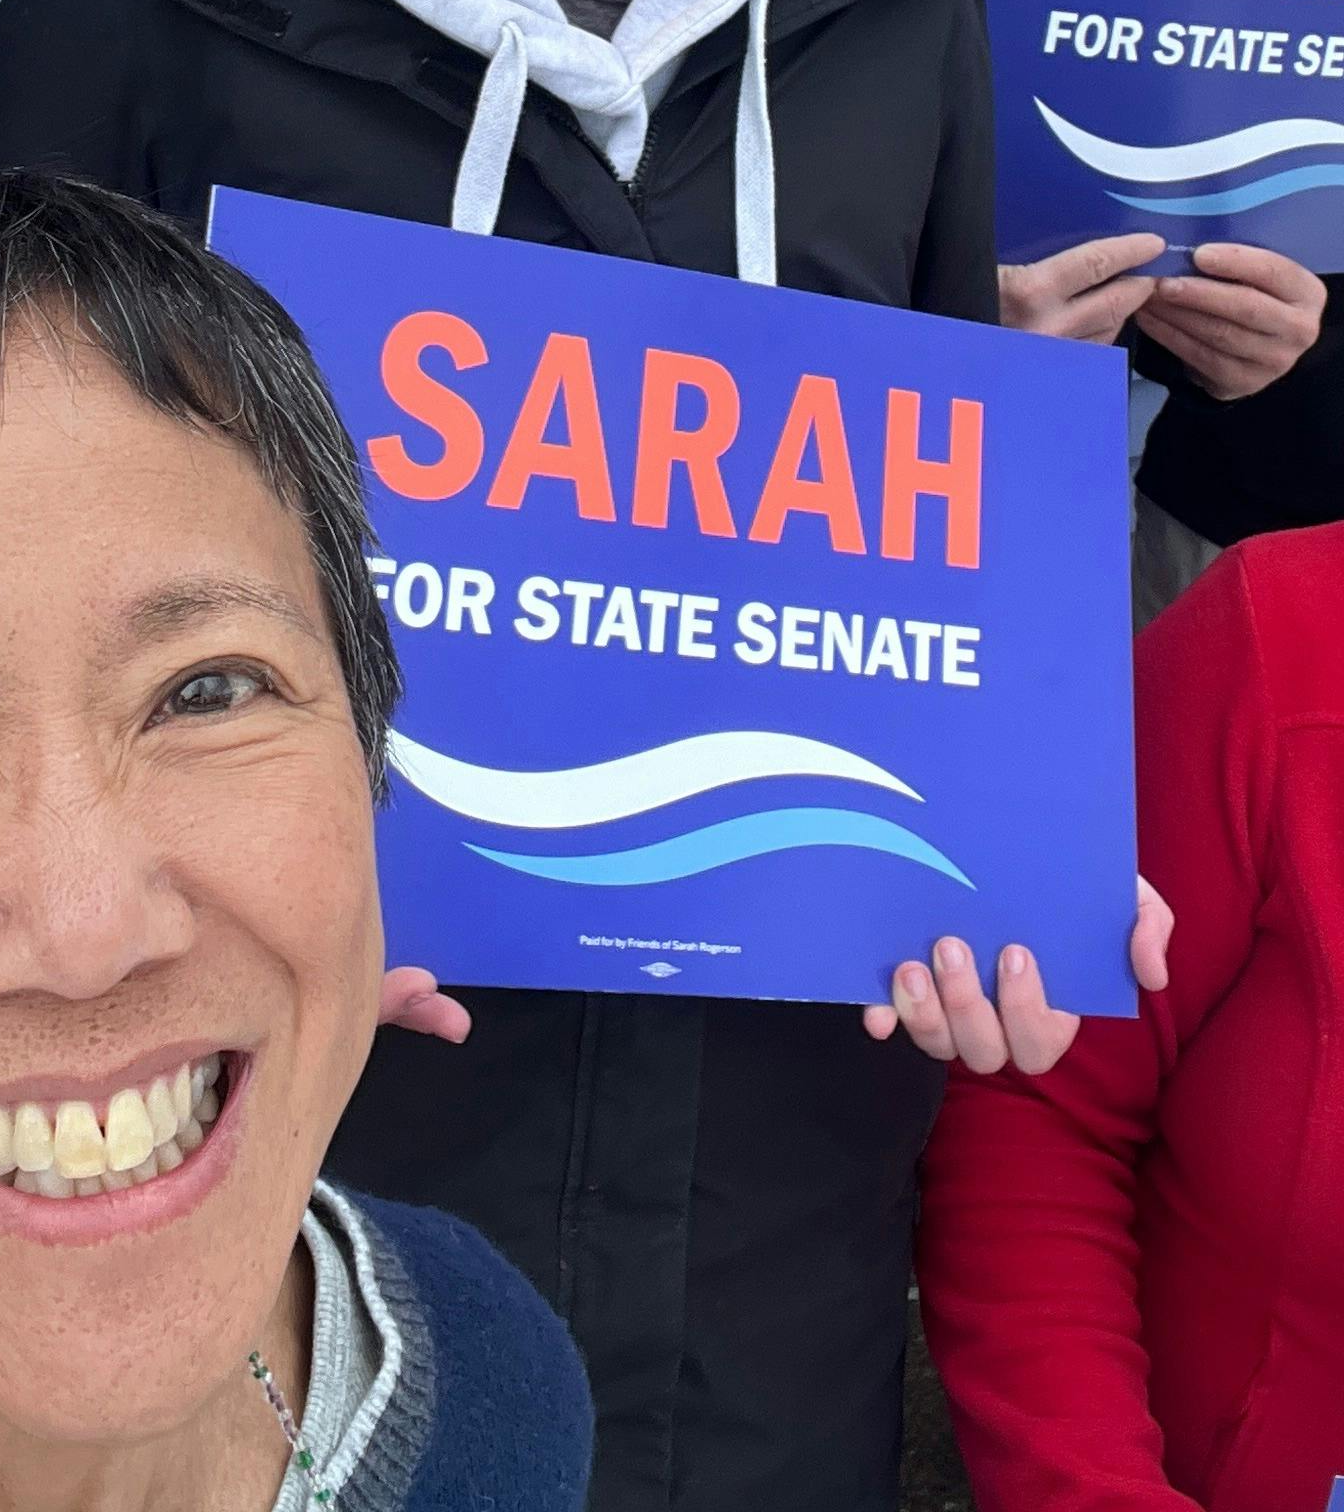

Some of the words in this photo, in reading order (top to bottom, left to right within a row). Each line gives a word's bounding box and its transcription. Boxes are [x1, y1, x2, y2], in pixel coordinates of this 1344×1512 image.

[1043, 10, 1144, 62] FOR
[1153, 21, 1289, 75] STATE
[367, 310, 984, 570] SARAH
[513, 575, 720, 660] STATE
[733, 601, 982, 688] SENATE
[580, 934, 600, 946] Paid
[601, 936, 613, 947] for
[615, 937, 626, 949] by
[627, 937, 660, 950] Friends
[661, 939, 672, 950] of
[672, 940, 697, 952] Sarah
[699, 942, 741, 955] Rogerson
